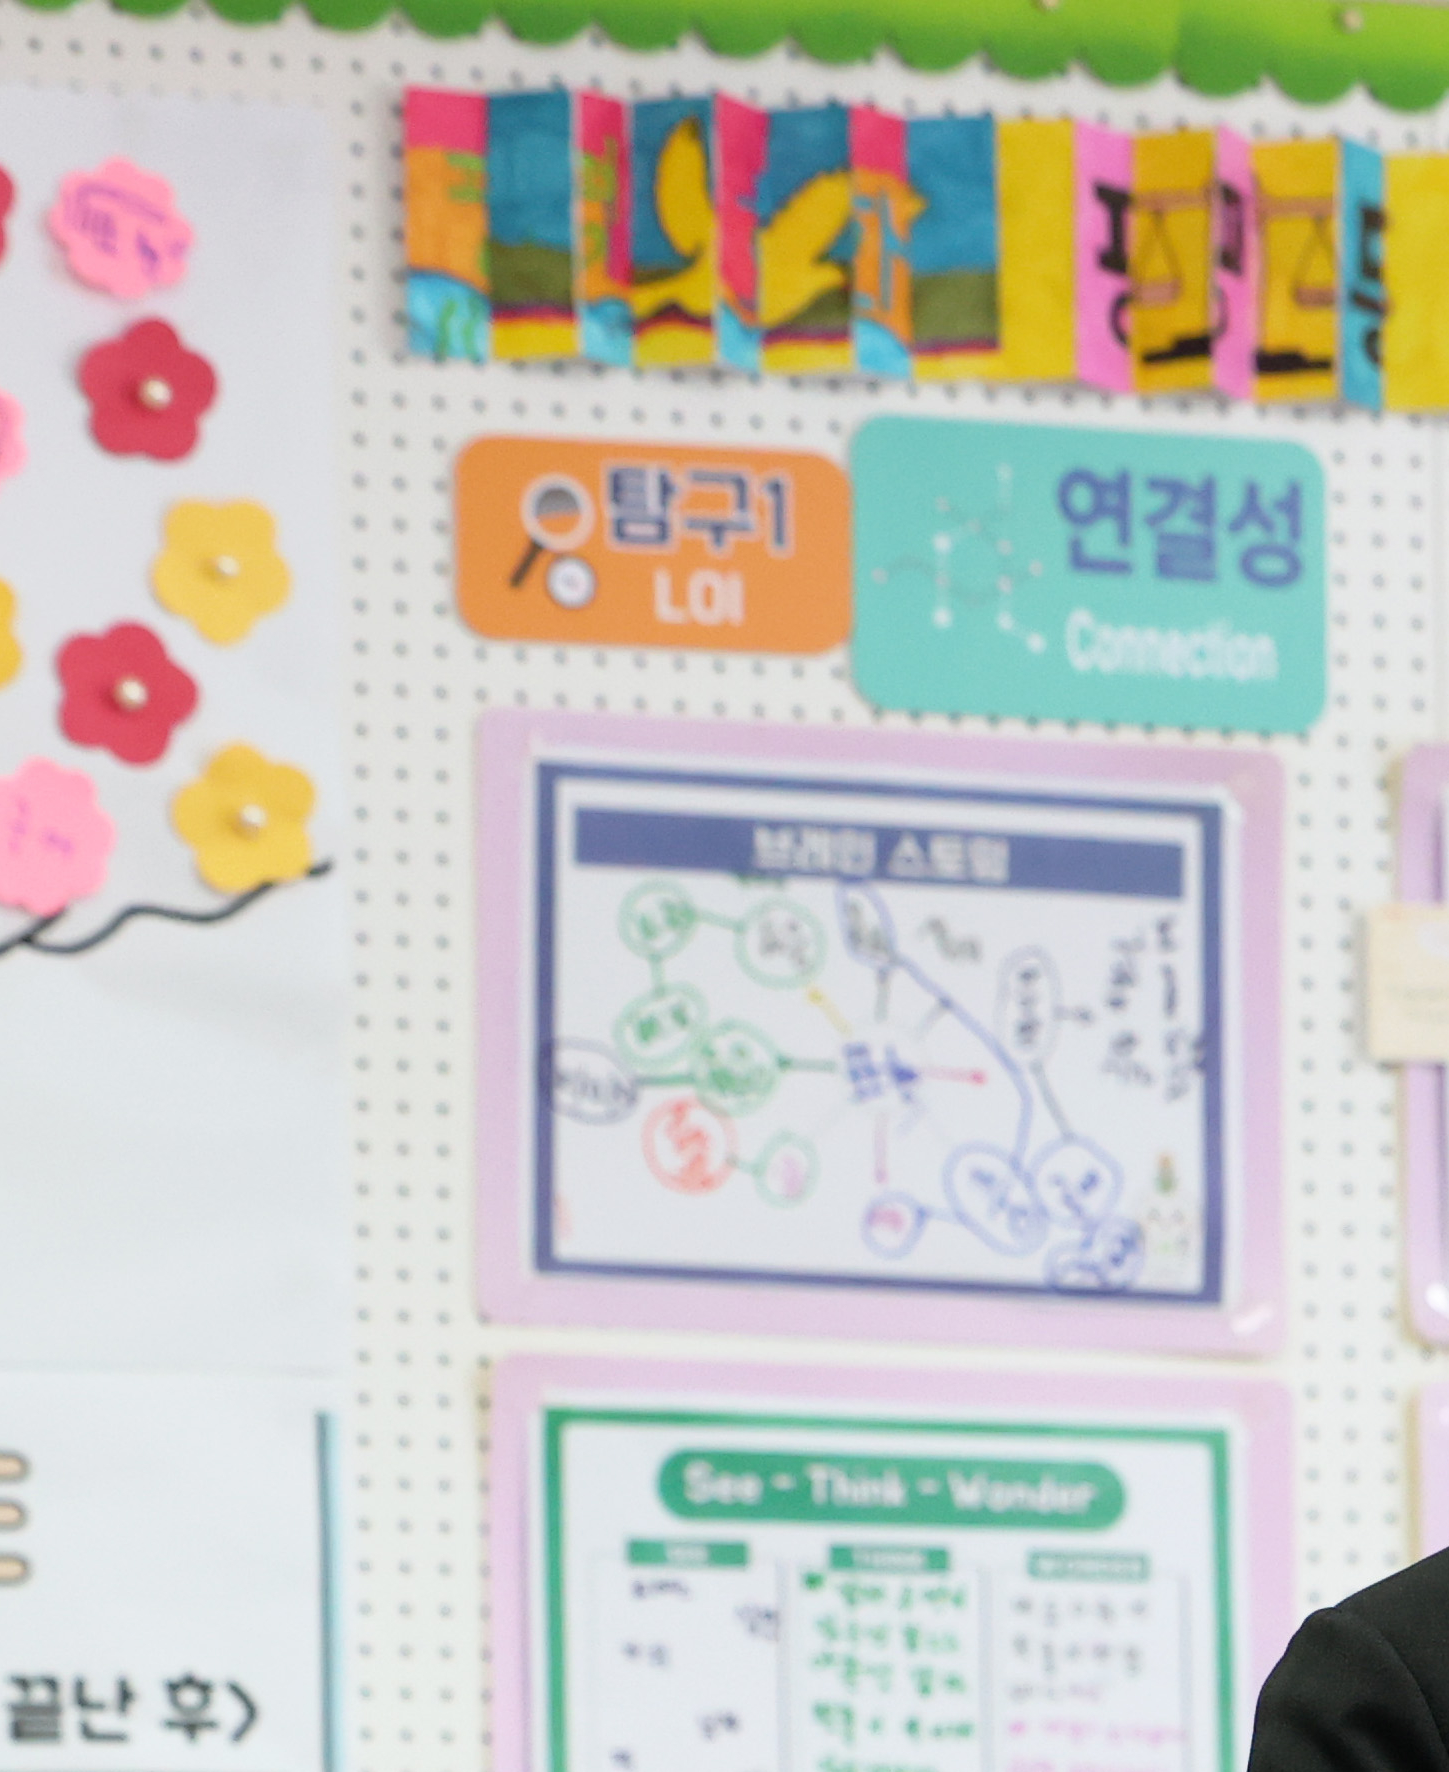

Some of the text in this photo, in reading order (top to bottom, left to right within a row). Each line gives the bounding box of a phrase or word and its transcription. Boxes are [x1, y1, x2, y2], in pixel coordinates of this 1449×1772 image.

[605, 462, 795, 556] 탐구1
[1058, 466, 1304, 590] 연결성
[654, 569, 744, 627] LOI
[1063, 609, 1279, 681] Connection
[5, 1675, 136, 1744] 끝난
